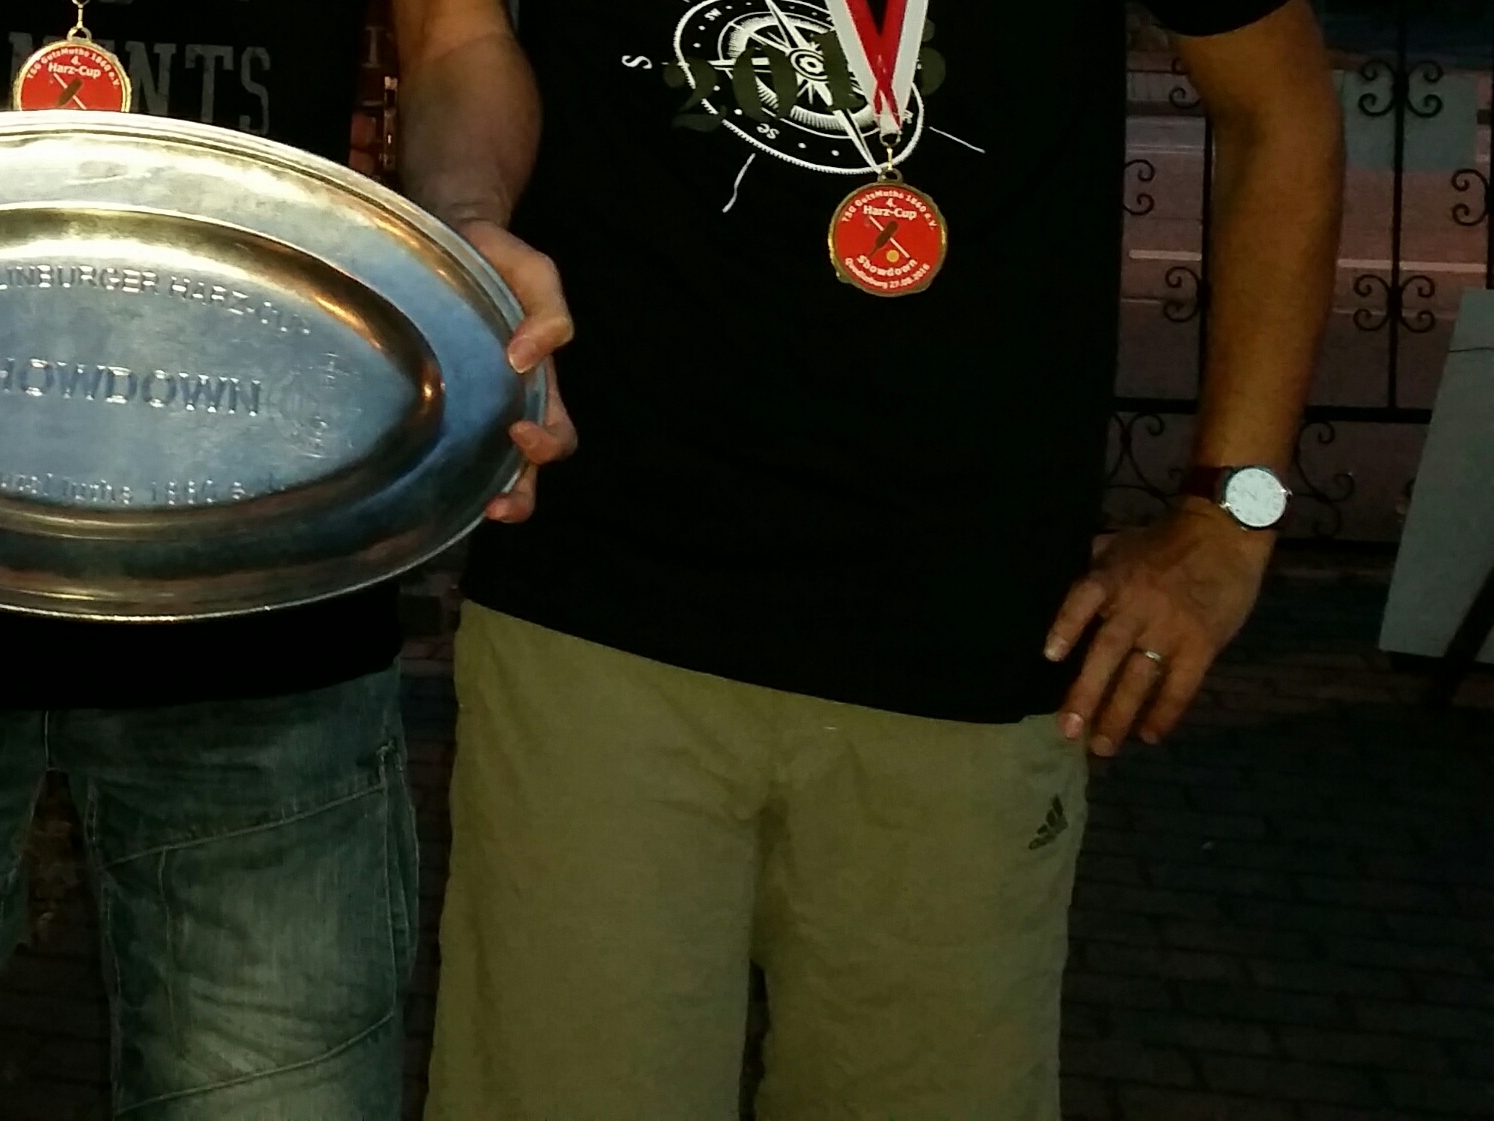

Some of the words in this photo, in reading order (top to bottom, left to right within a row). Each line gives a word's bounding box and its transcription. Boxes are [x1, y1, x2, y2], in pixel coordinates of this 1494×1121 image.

[47, 62, 102, 80] Harz-Cup
[862, 204, 918, 221] Harz-Cup
[856, 254, 918, 277] Showdown
